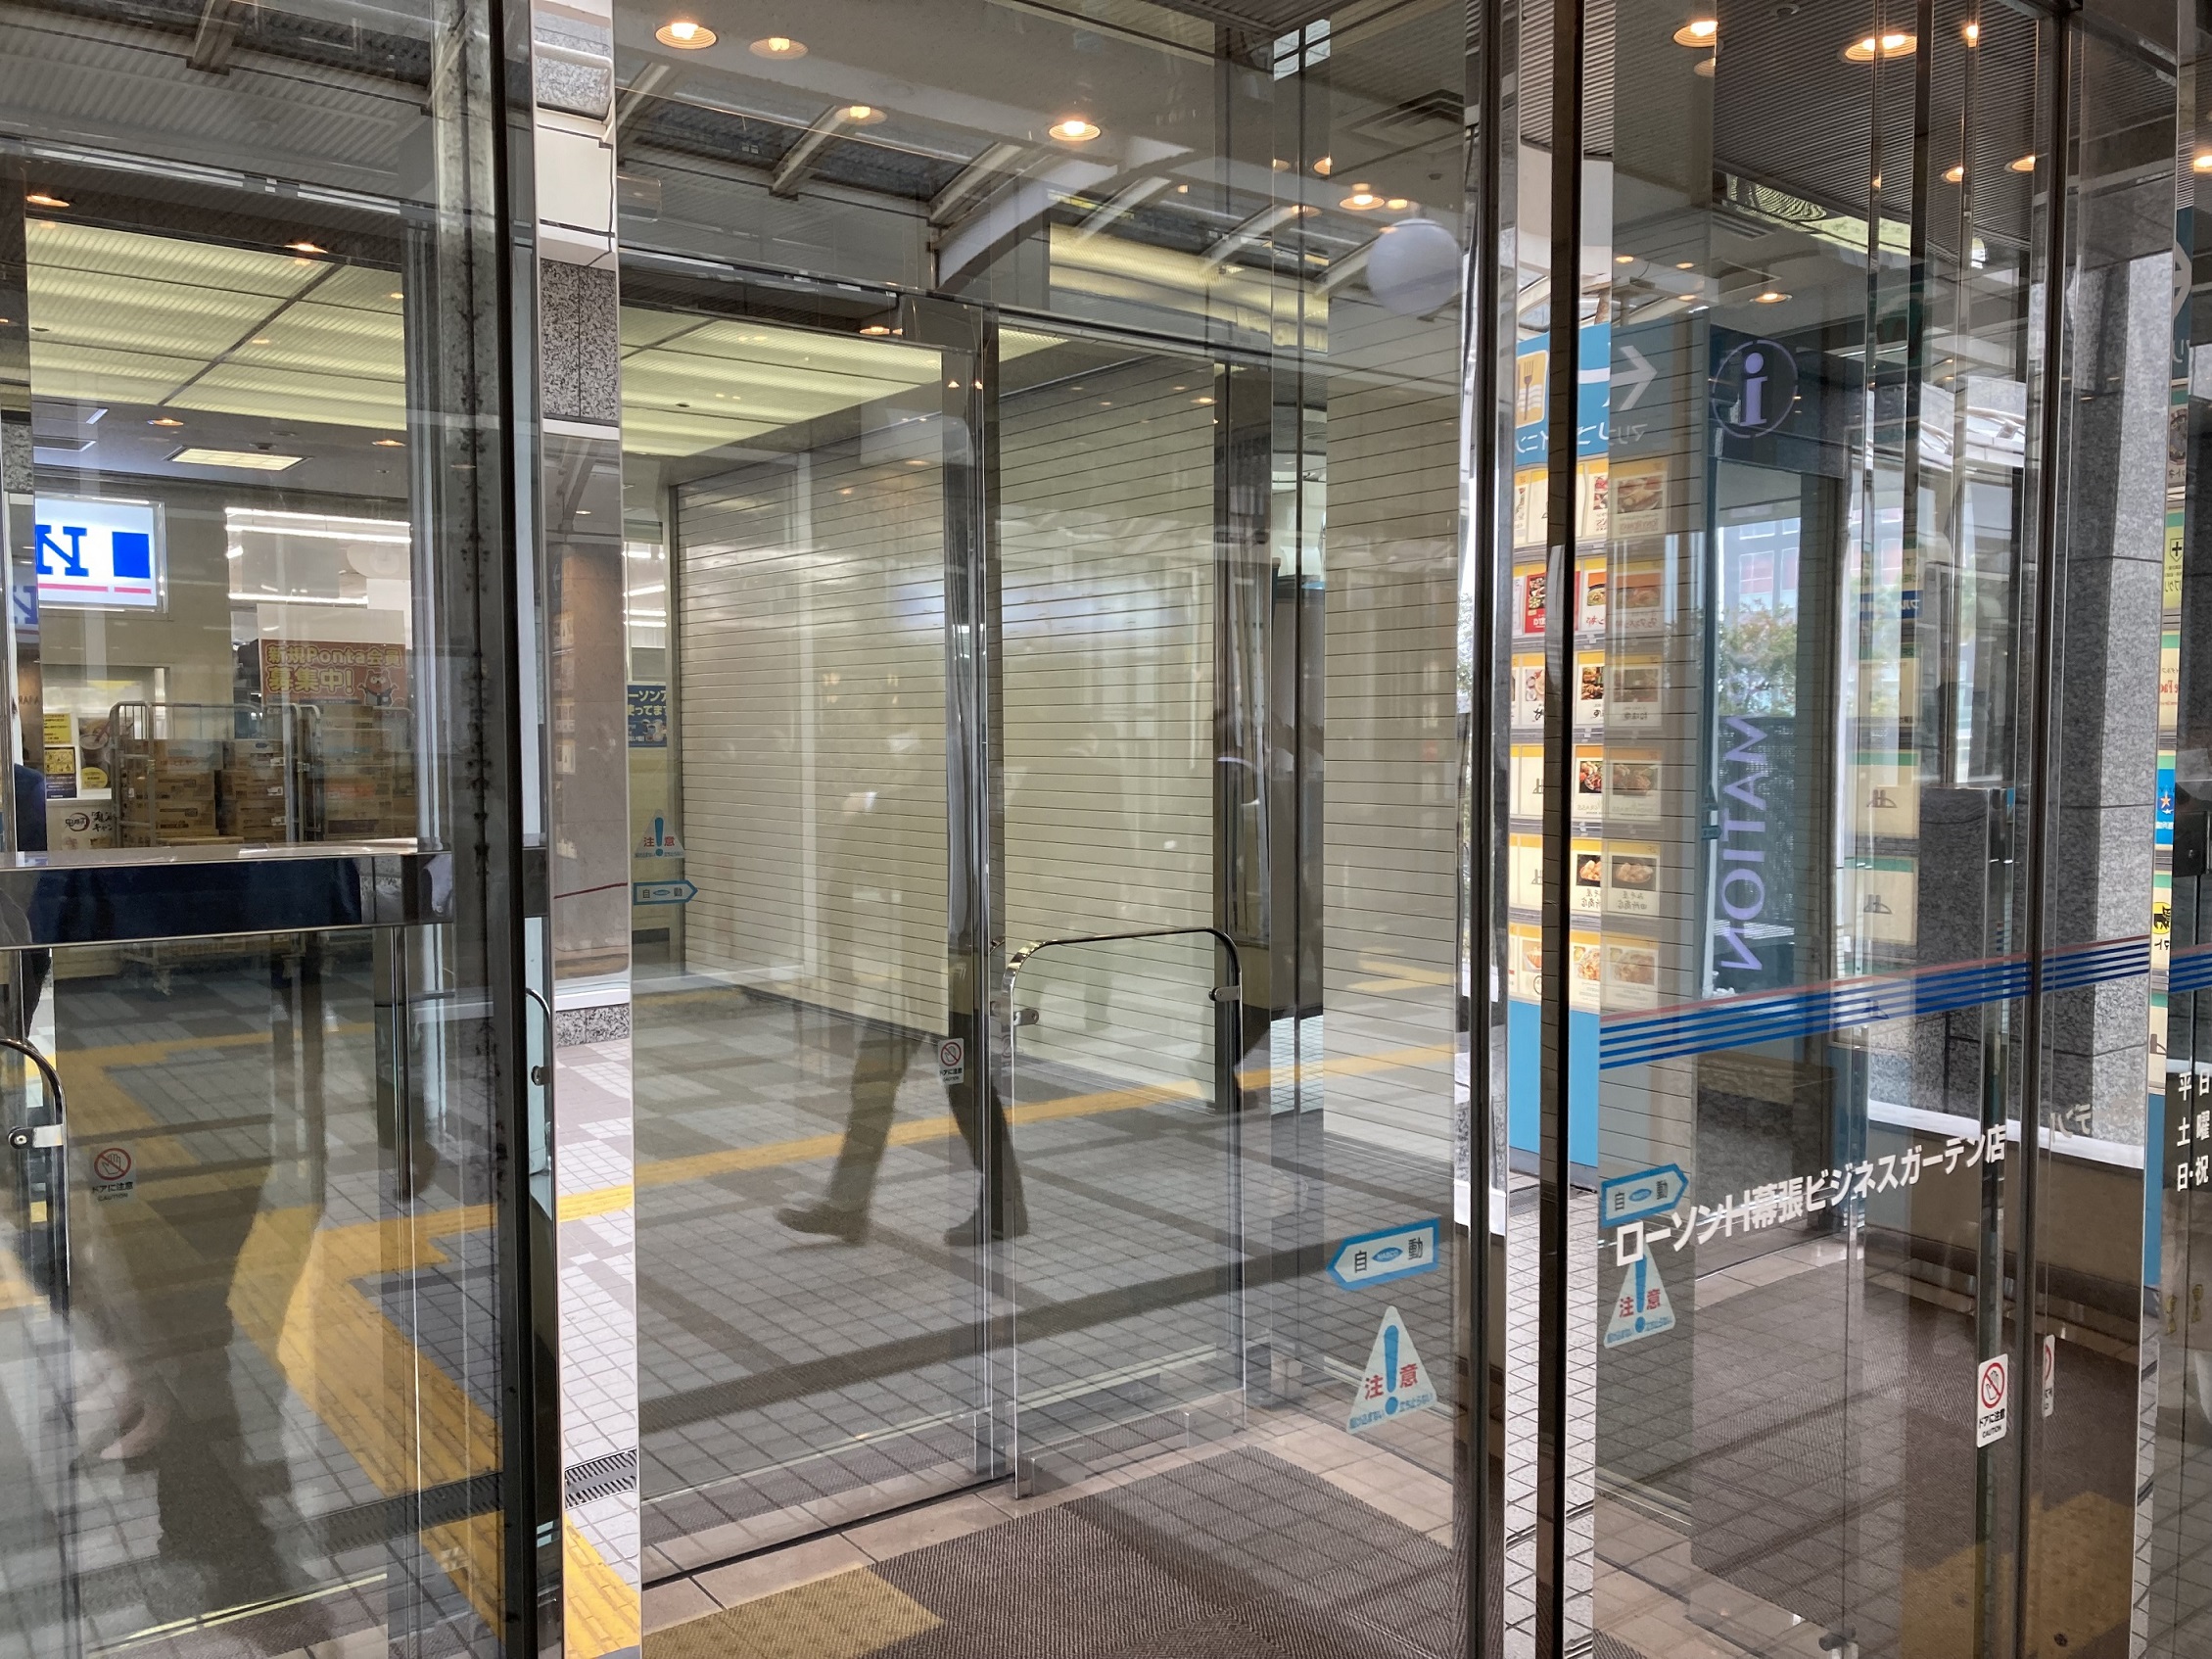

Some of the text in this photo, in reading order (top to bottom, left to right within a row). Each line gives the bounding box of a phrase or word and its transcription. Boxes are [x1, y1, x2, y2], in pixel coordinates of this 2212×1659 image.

[266, 644, 401, 667] 新規Ponta会員
[2177, 1110, 2210, 1147] 土曜
[92, 1181, 134, 1194] ドアに注意
[98, 1192, 128, 1202] CAUTION
[1365, 1363, 1418, 1400] 注意
[1979, 1408, 2005, 1429] ドアに注意
[1983, 1424, 2001, 1439] CAUTION
